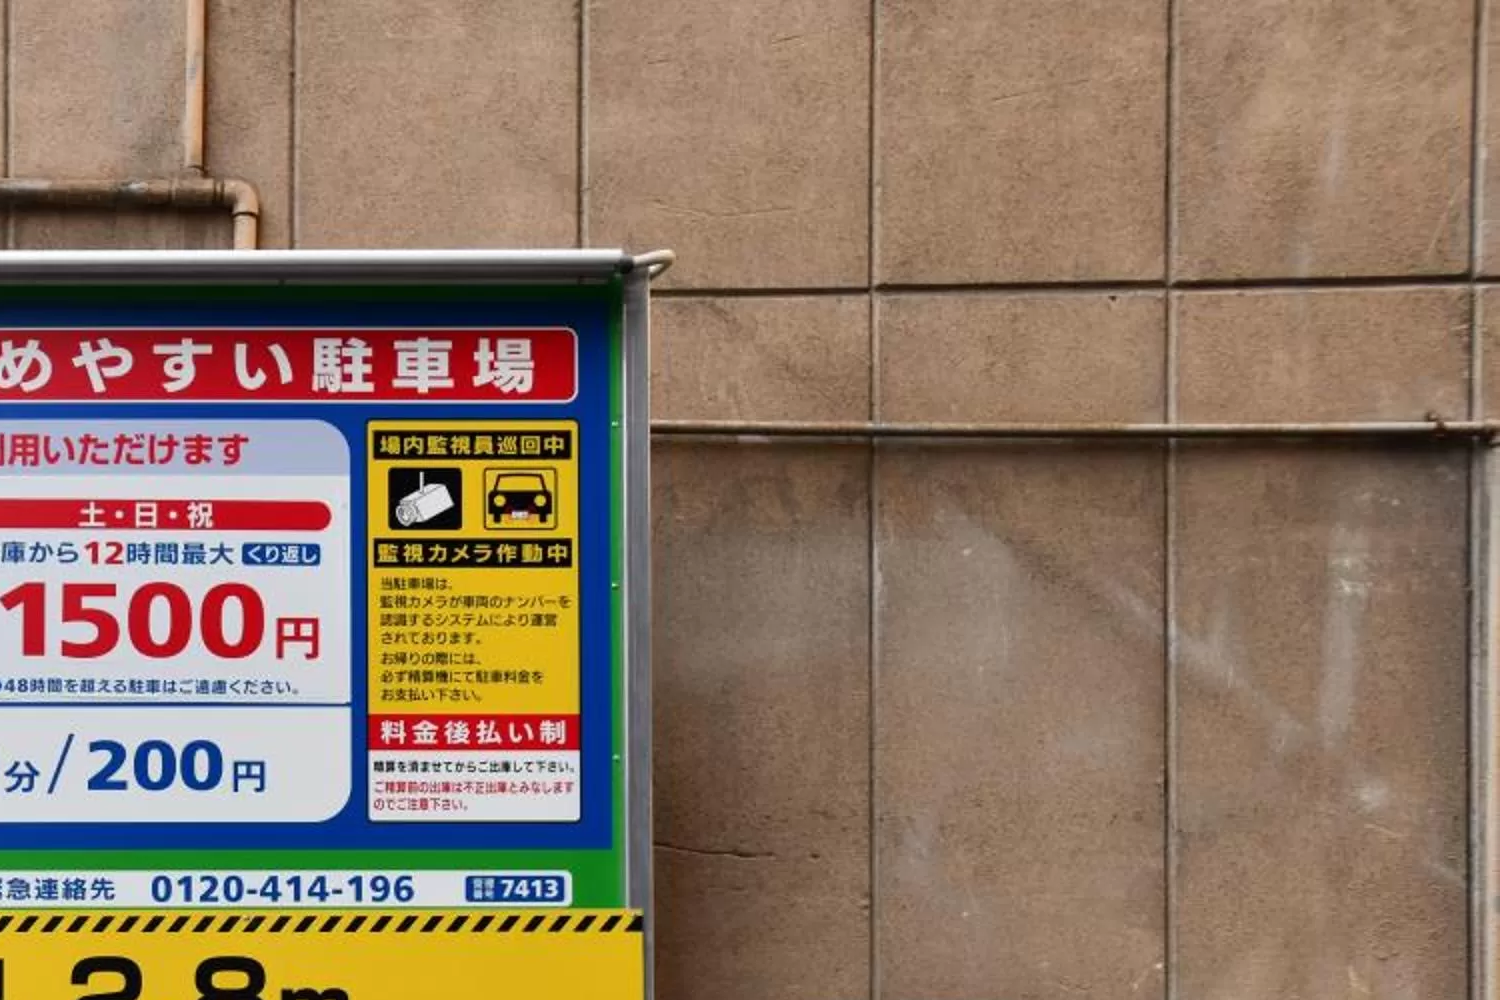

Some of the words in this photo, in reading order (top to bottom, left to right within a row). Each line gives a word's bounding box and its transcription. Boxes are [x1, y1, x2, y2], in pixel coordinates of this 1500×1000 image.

[380, 436, 564, 455] 場内監視員巡回中
[378, 544, 567, 562] 監視カメラ作動中
[381, 720, 565, 744] 料金後払い制
[152, 876, 414, 902] 0120-414-196
